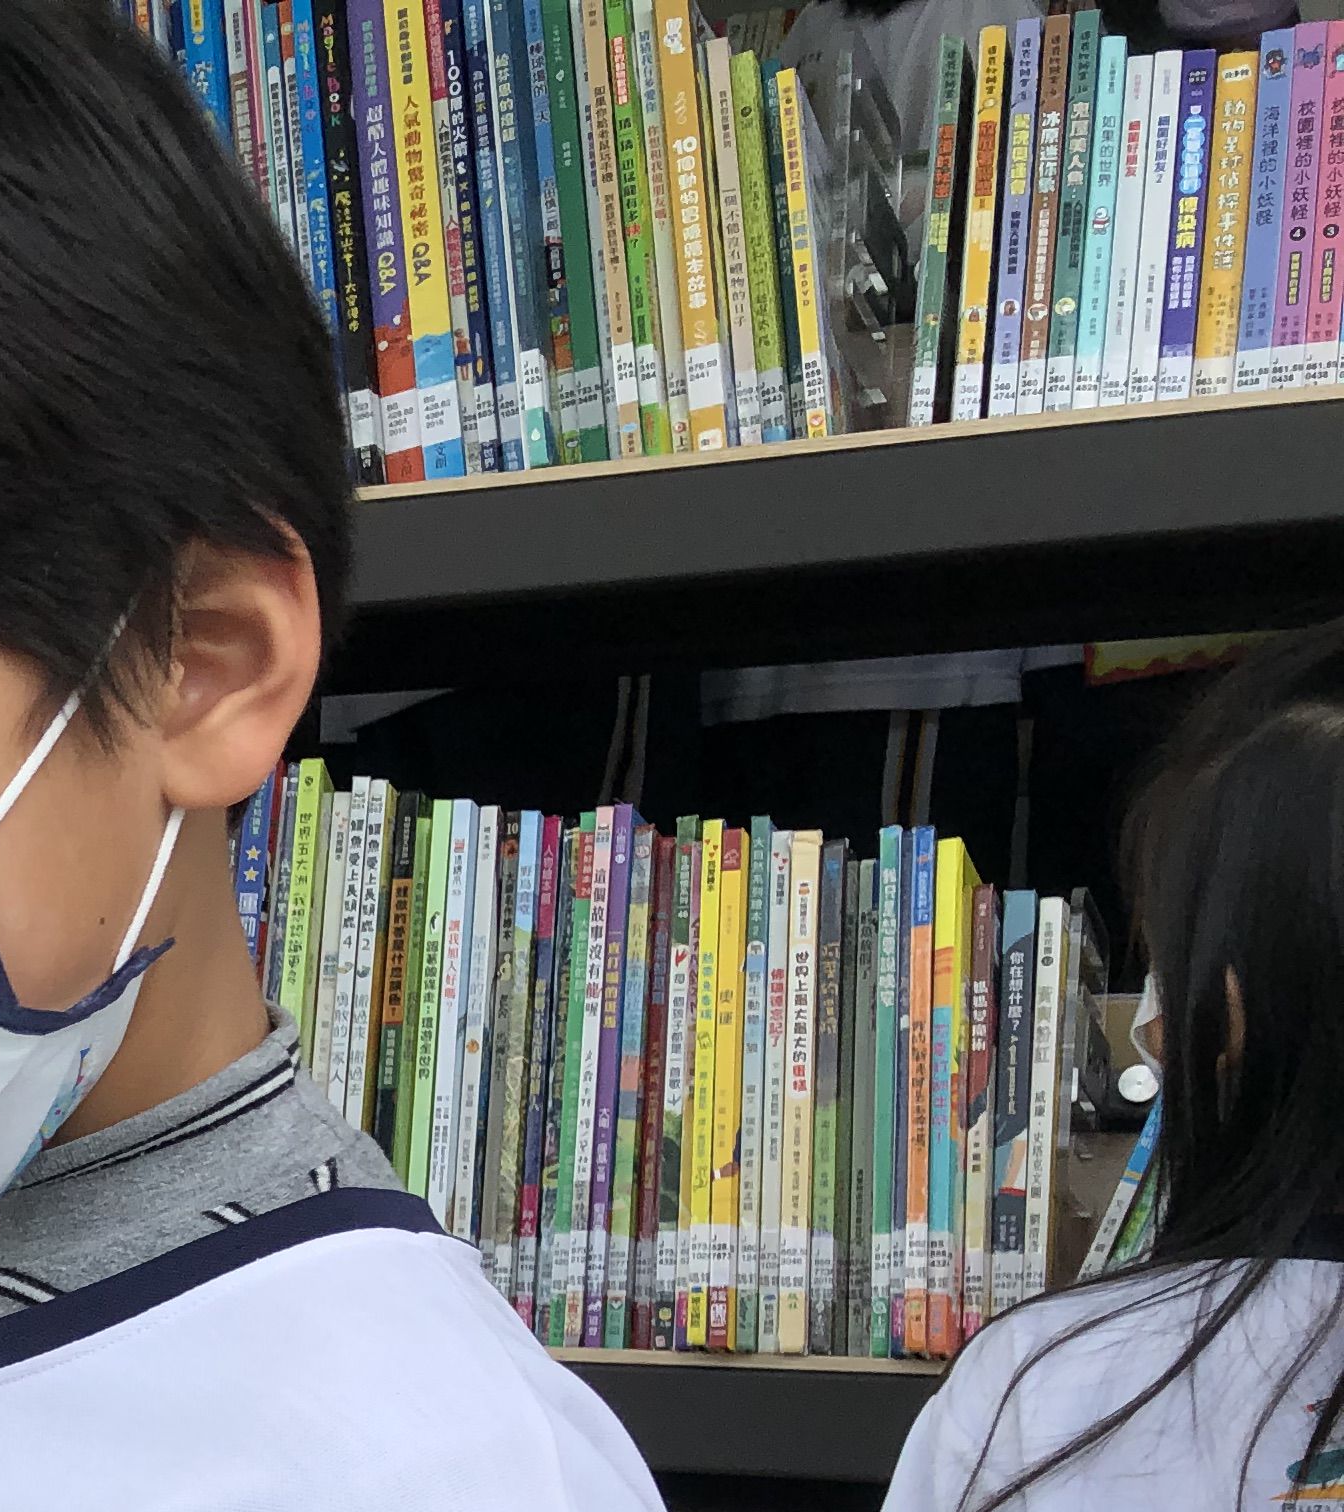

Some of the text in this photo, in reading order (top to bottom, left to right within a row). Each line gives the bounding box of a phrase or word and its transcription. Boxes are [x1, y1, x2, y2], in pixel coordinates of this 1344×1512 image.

[1097, 115, 1116, 188] 如果的世界
[1255, 105, 1281, 228] 海洋裡的小妖怪
[1290, 99, 1316, 222] 校園裡的小妖怪
[1323, 97, 1344, 219] 校園裡的小妖怪
[376, 250, 397, 296] Q&A
[412, 241, 433, 287] Q&A
[294, 812, 312, 887] 世界五大洲
[342, 819, 365, 950] 鱷魚愛上長頸鹿 4
[361, 823, 381, 951] 鱷魚愛上長頸鹿 2
